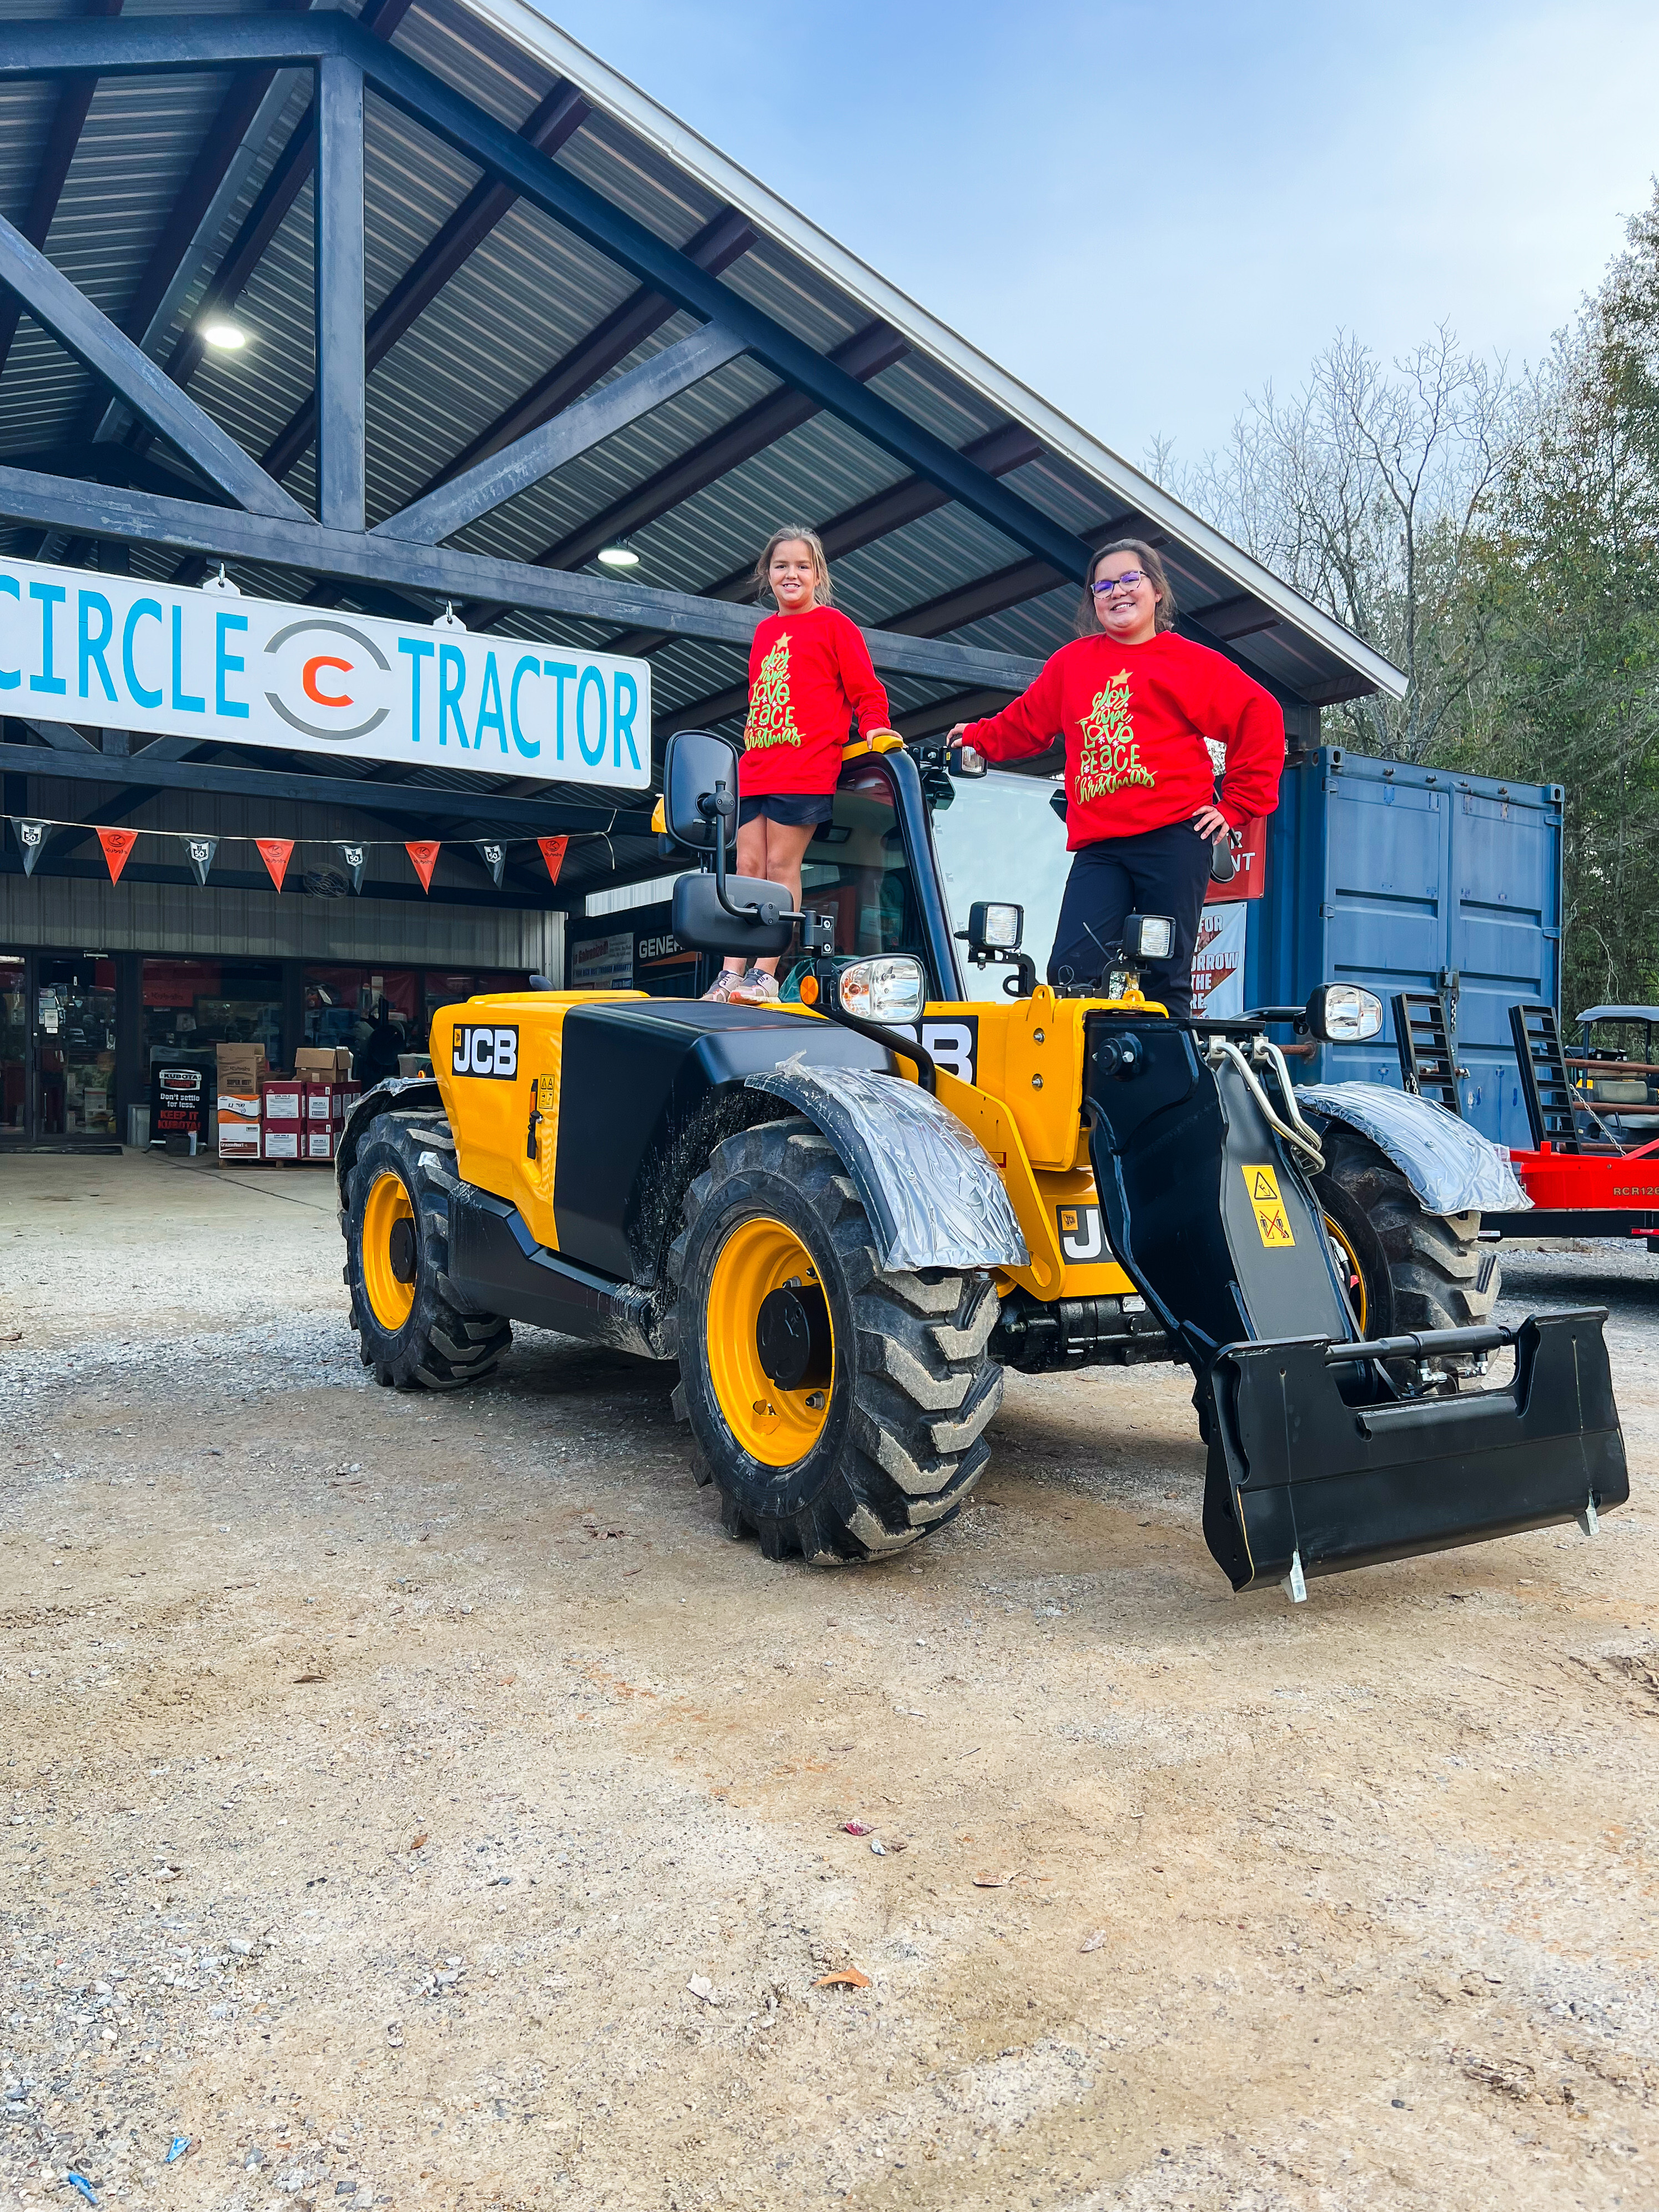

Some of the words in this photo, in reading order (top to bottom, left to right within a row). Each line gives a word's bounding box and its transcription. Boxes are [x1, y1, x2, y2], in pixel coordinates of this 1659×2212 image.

[303, 656, 354, 707] C
[398, 637, 641, 770] TRACTOR
[1092, 680, 1134, 710] Joy
[1074, 707, 1132, 730] hope
[1074, 767, 1158, 805] Christmas
[1198, 914, 1223, 933] FOR
[454, 1028, 517, 1075] JCB
[158, 1120, 202, 1130] KUBOTA!
[160, 1110, 187, 1120] KEEP
[189, 1112, 199, 1120] IT
